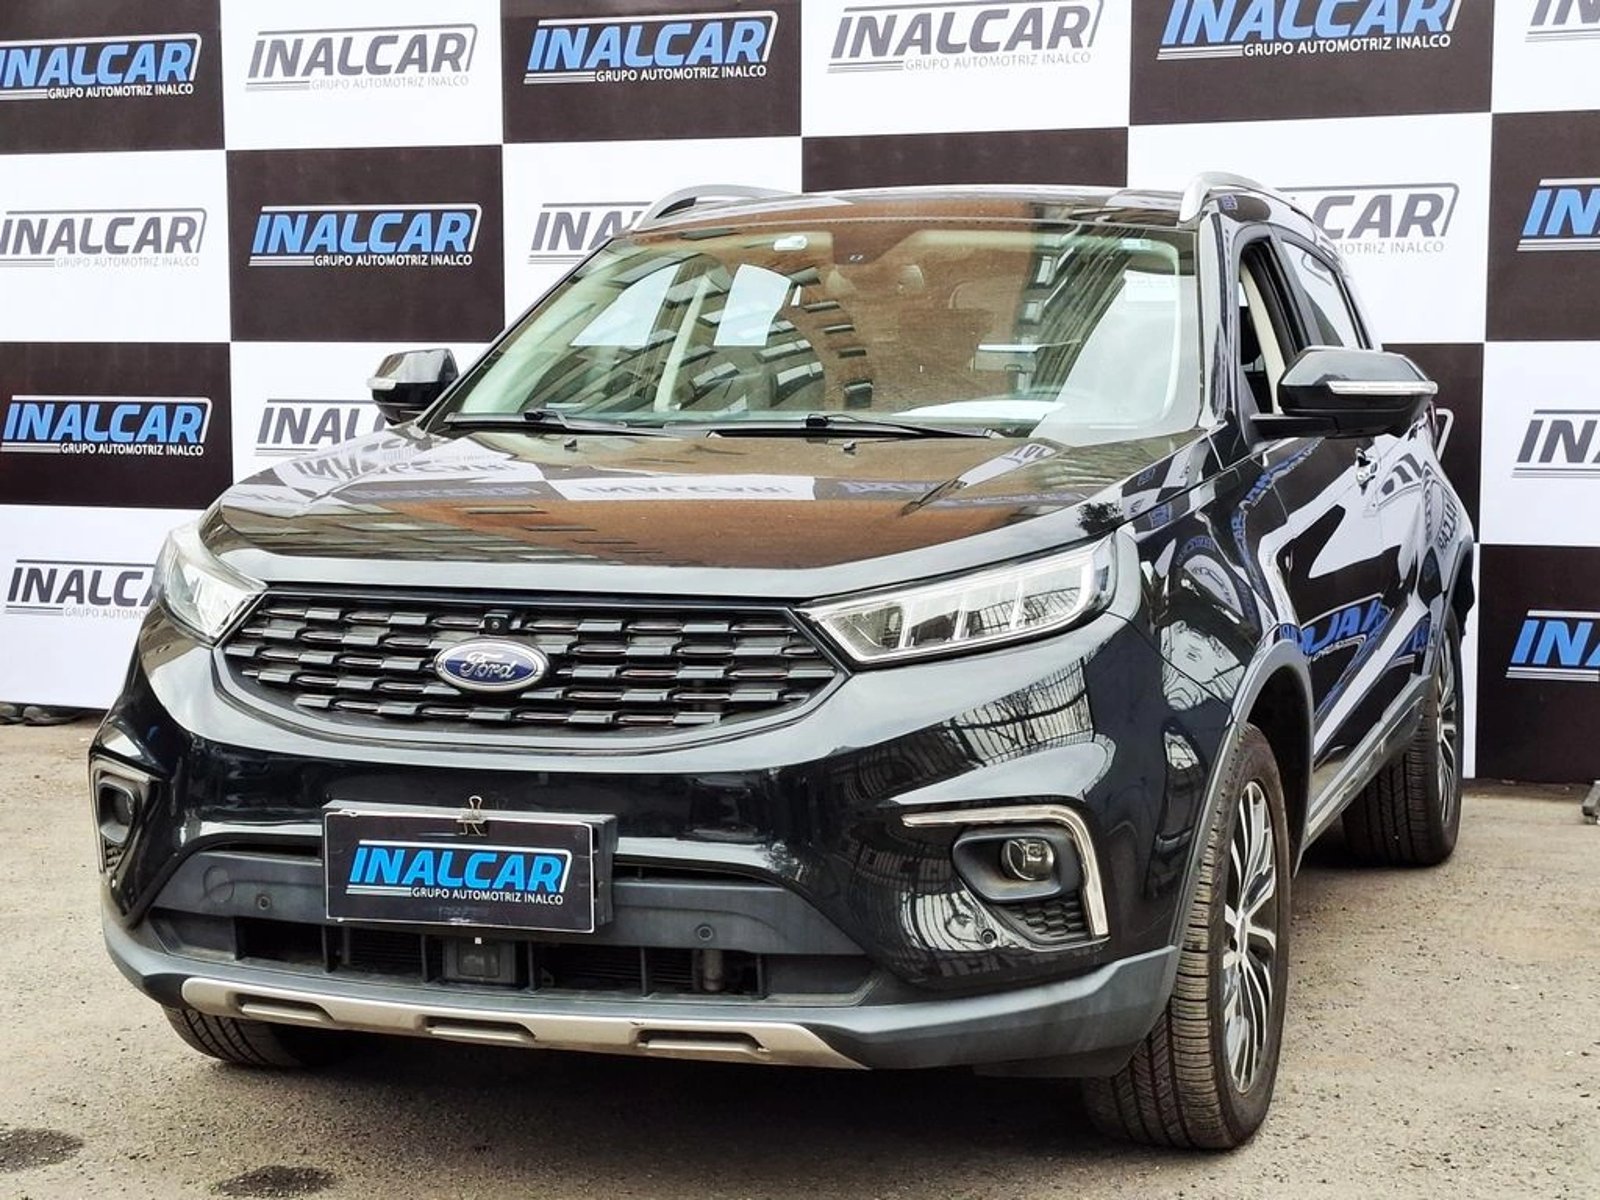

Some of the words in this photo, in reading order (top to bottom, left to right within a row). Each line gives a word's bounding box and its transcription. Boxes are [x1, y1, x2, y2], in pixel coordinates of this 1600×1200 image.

[830, 6, 1090, 58] INALCAR
[1161, 0, 1449, 45] INALCAR
[248, 32, 467, 78] INALCAR
[527, 19, 766, 70] INALCAR
[905, 58, 949, 71] GRUPO
[954, 54, 1038, 69] AUTOMOTRIZ
[1041, 51, 1091, 65] INALCO
[1244, 42, 1292, 56] GRUPO
[1297, 37, 1391, 54] AUTOMOTRIZ
[1396, 34, 1450, 49] INALCO
[0, 42, 192, 88] NALCAR
[312, 79, 349, 91] GRUPO
[352, 76, 424, 89] AUTOMOTRIZ
[427, 75, 469, 87] INALCO
[596, 69, 637, 83] GRUPO
[640, 67, 718, 81] AUTOMOTRIZ
[721, 65, 767, 78] INALCO
[48, 86, 84, 99] GRUPO
[86, 84, 153, 98] AUTOMOTRIZ
[155, 83, 194, 95] INALCO
[0, 217, 197, 255] INALCAR
[252, 212, 472, 253] INALCAR
[531, 211, 643, 250] INA
[1391, 241, 1444, 253] INALCO
[56, 257, 90, 268] GRUPO
[94, 256, 158, 268] AUTOMOTRIZ
[162, 256, 199, 267] INALCO
[315, 254, 353, 267] GRUPO
[356, 254, 428, 266] AUTOMOTRIZ
[431, 254, 472, 266] INALCO
[3, 403, 202, 443] INALCAR
[257, 407, 386, 444] INAL
[1516, 419, 1600, 463] IN
[61, 443, 96, 454] GRUPO
[98, 443, 164, 455] AUTOMOTRIZ
[166, 444, 204, 456] INALCO
[1510, 620, 1600, 667] IN
[460, 651, 517, 679] Ford
[349, 847, 563, 893] INALCAR
[412, 887, 449, 898] GRUPO
[453, 889, 521, 903] AUTOMOTRIZ
[524, 893, 563, 905] INALCO
